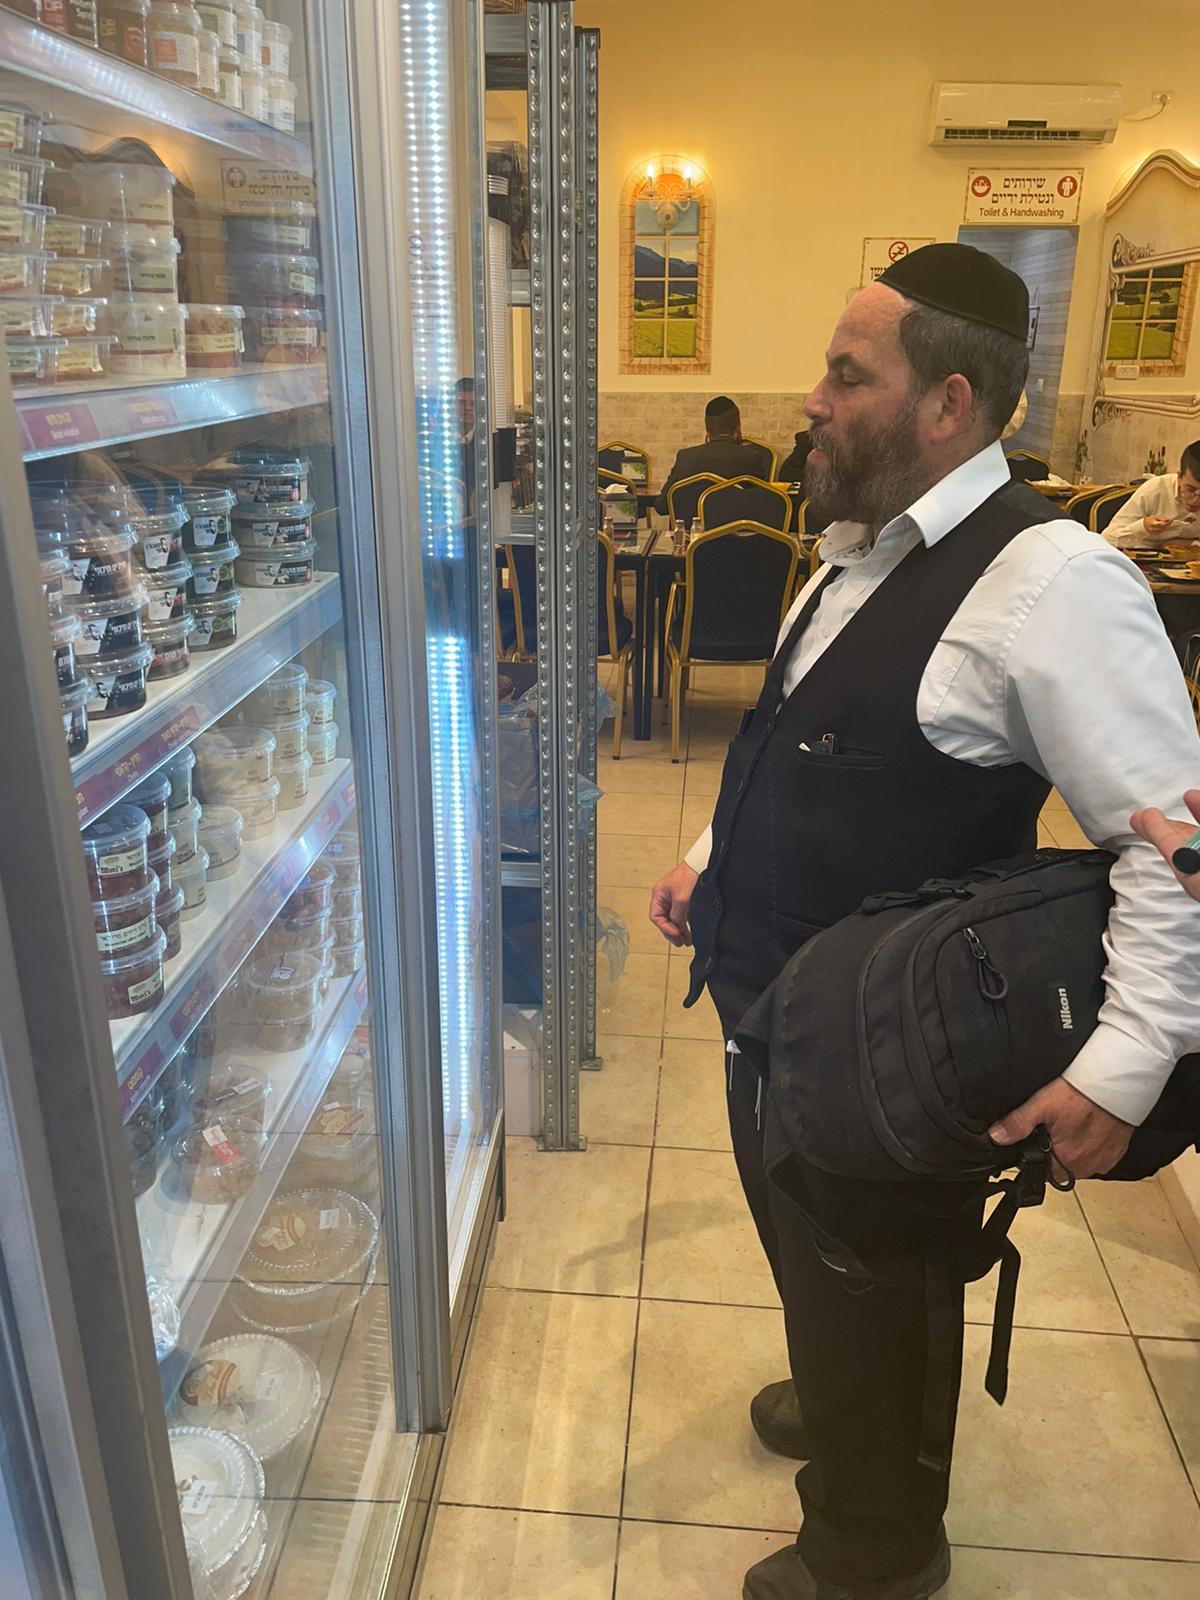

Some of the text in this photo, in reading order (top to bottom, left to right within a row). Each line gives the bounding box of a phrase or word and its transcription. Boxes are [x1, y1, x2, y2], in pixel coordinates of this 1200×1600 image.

[1003, 177, 1046, 189] שירותים
[991, 189, 1055, 204] ונטילת ידיים
[978, 207, 1064, 219] Toilet & Handwashing
[1058, 988, 1073, 1029] Nikon
